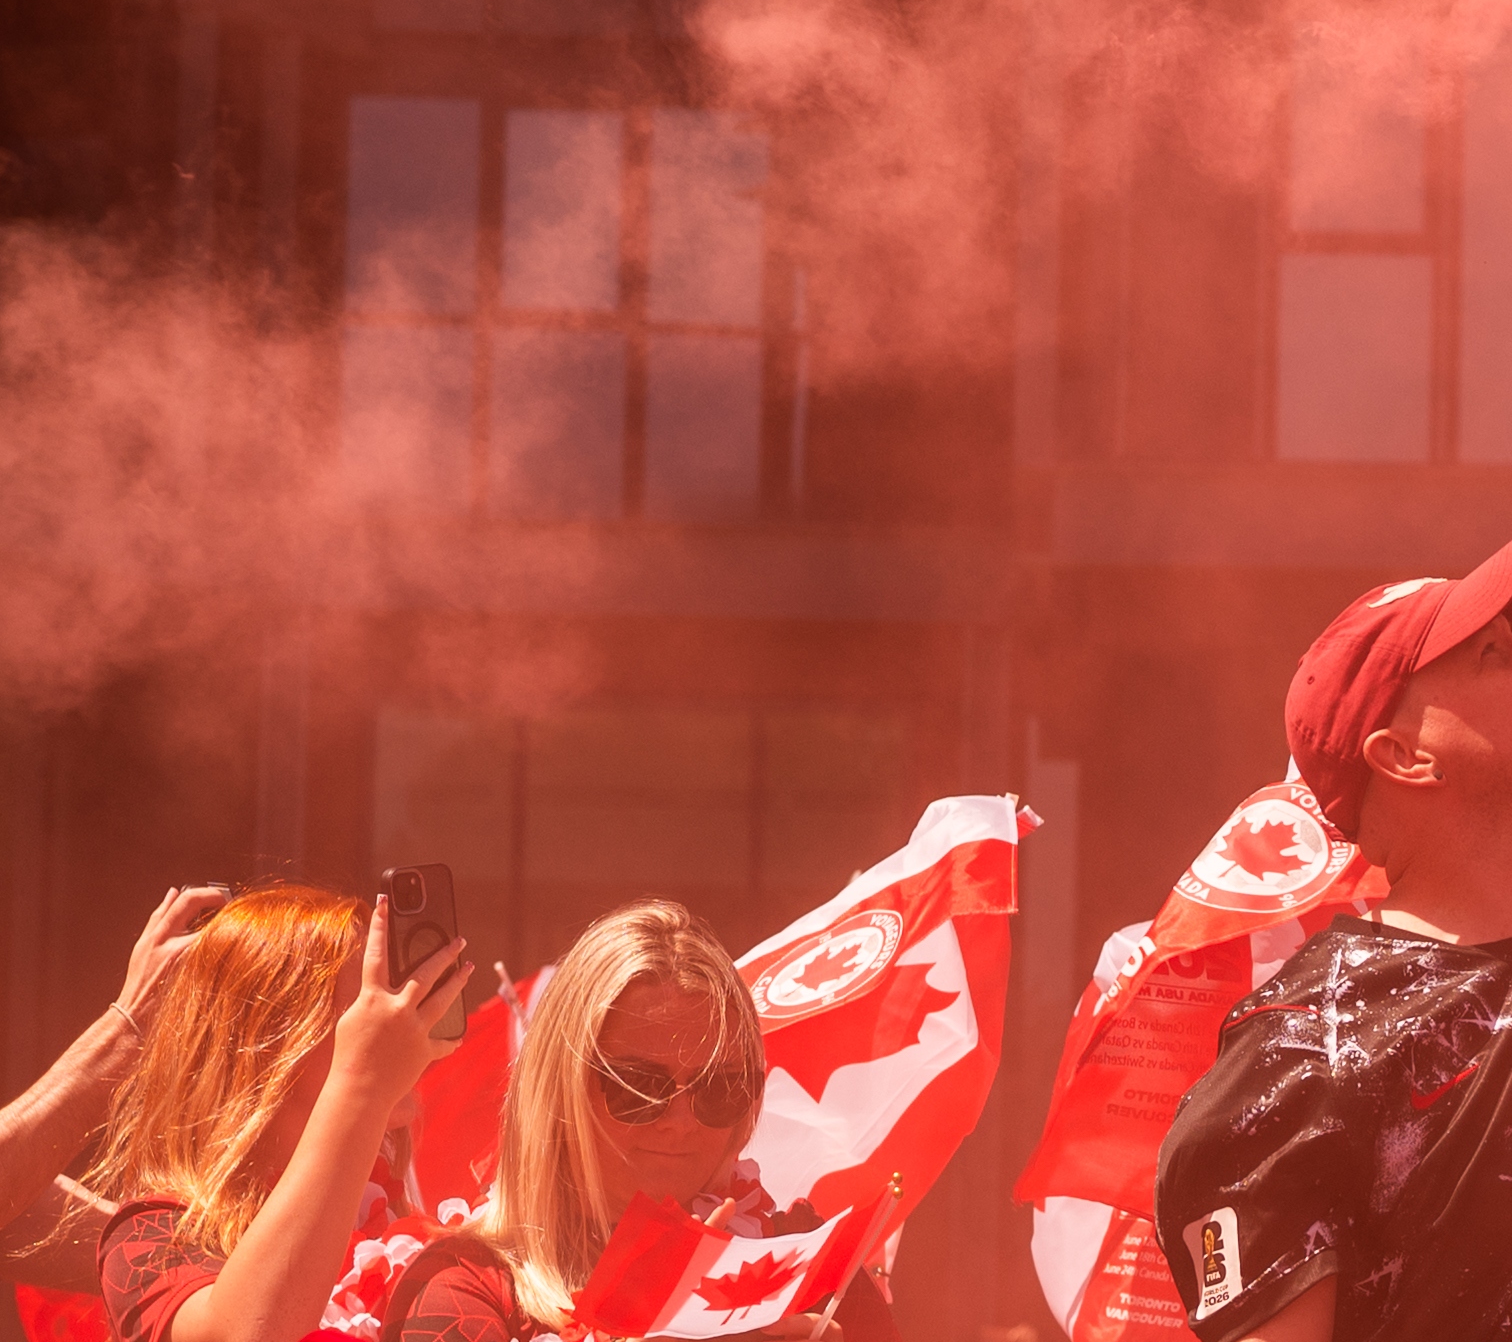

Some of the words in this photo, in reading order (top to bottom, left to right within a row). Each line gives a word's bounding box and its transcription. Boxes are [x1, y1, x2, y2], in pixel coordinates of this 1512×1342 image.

[1122, 1233, 1143, 1247] June
[1118, 1248, 1138, 1261] June
[1103, 1263, 1121, 1275] June
[1139, 1266, 1170, 1282] Canada
[1206, 1271, 1221, 1283] FIFA
[1119, 1292, 1182, 1313] TORONTO
[1105, 1305, 1184, 1329] VANCOUVER
